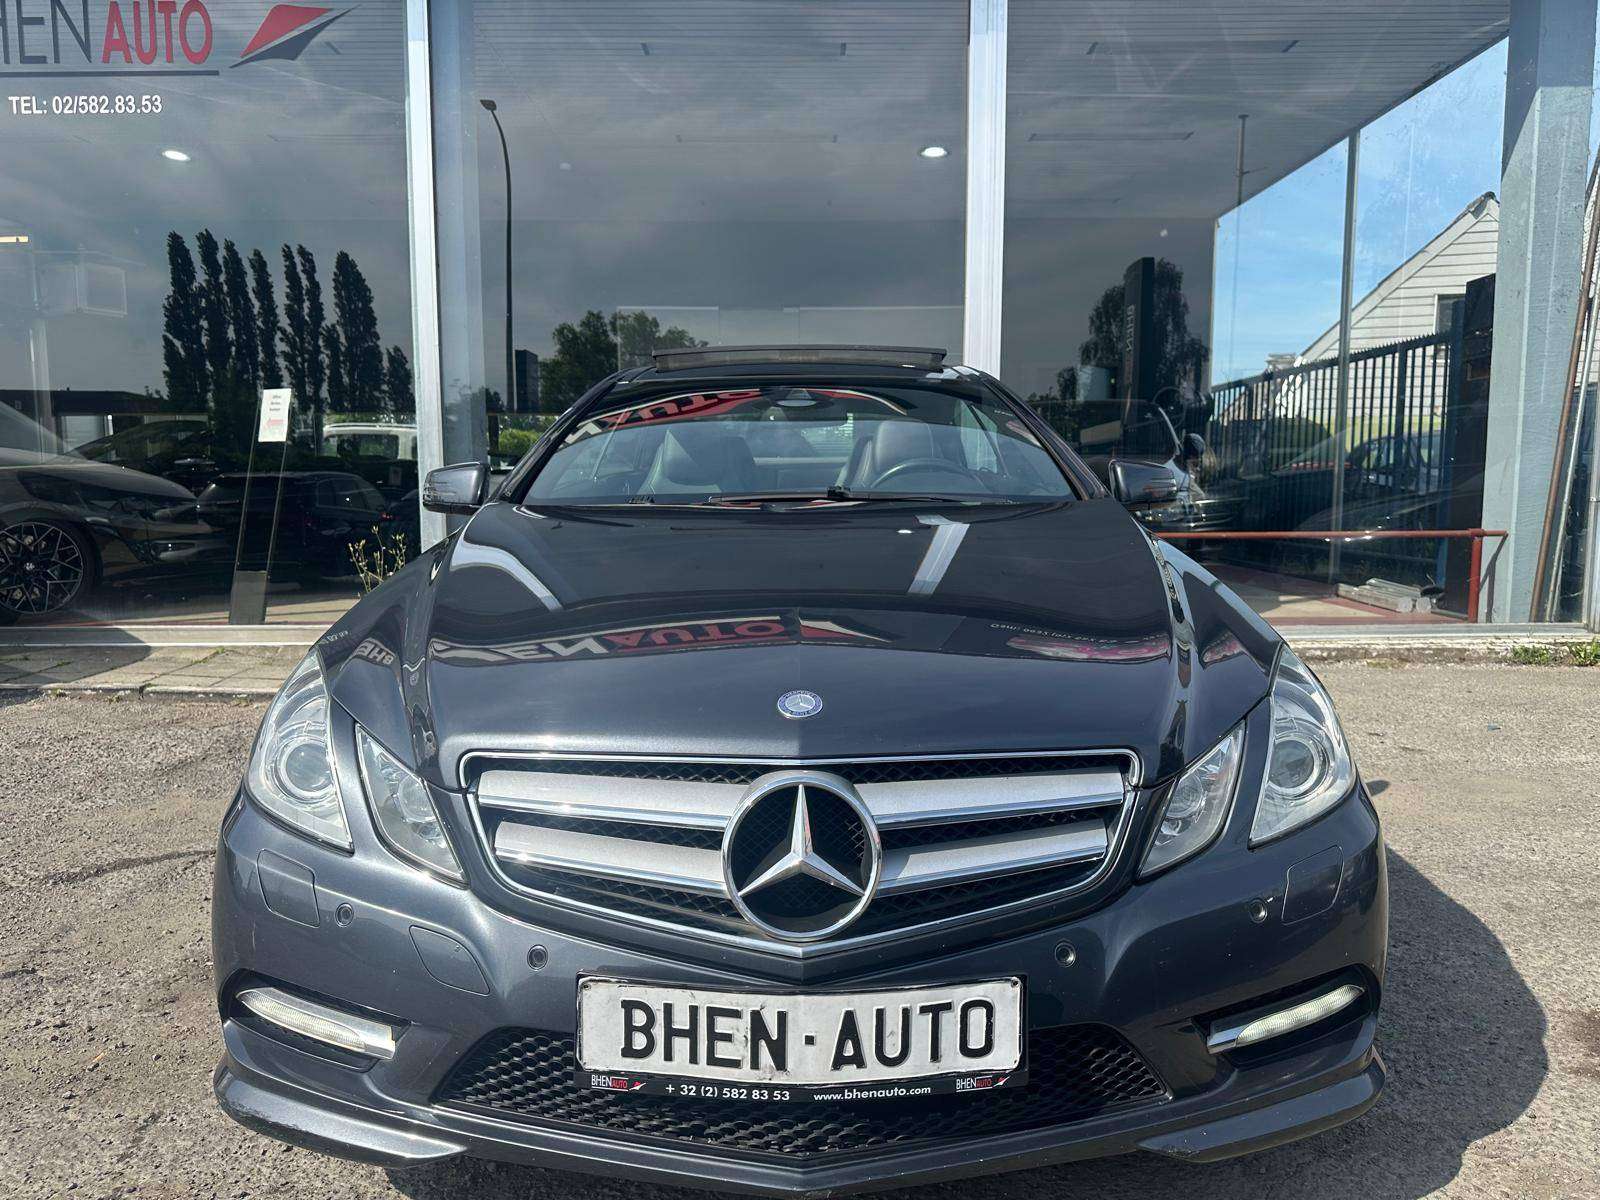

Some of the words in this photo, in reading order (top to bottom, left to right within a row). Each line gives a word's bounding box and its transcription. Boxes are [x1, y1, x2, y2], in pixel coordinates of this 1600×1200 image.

[8, 96, 48, 115] TEL:
[52, 94, 163, 115] 02/582.83.53
[620, 999, 789, 1071] BHEN
[830, 998, 996, 1072] AUTO
[680, 1084, 697, 1096] 32
[700, 1085, 719, 1098] (2)
[722, 1087, 748, 1099] 582
[751, 1088, 769, 1100] 83
[772, 1089, 790, 1101] 53
[813, 1086, 931, 1101] www.bhenauto.com
